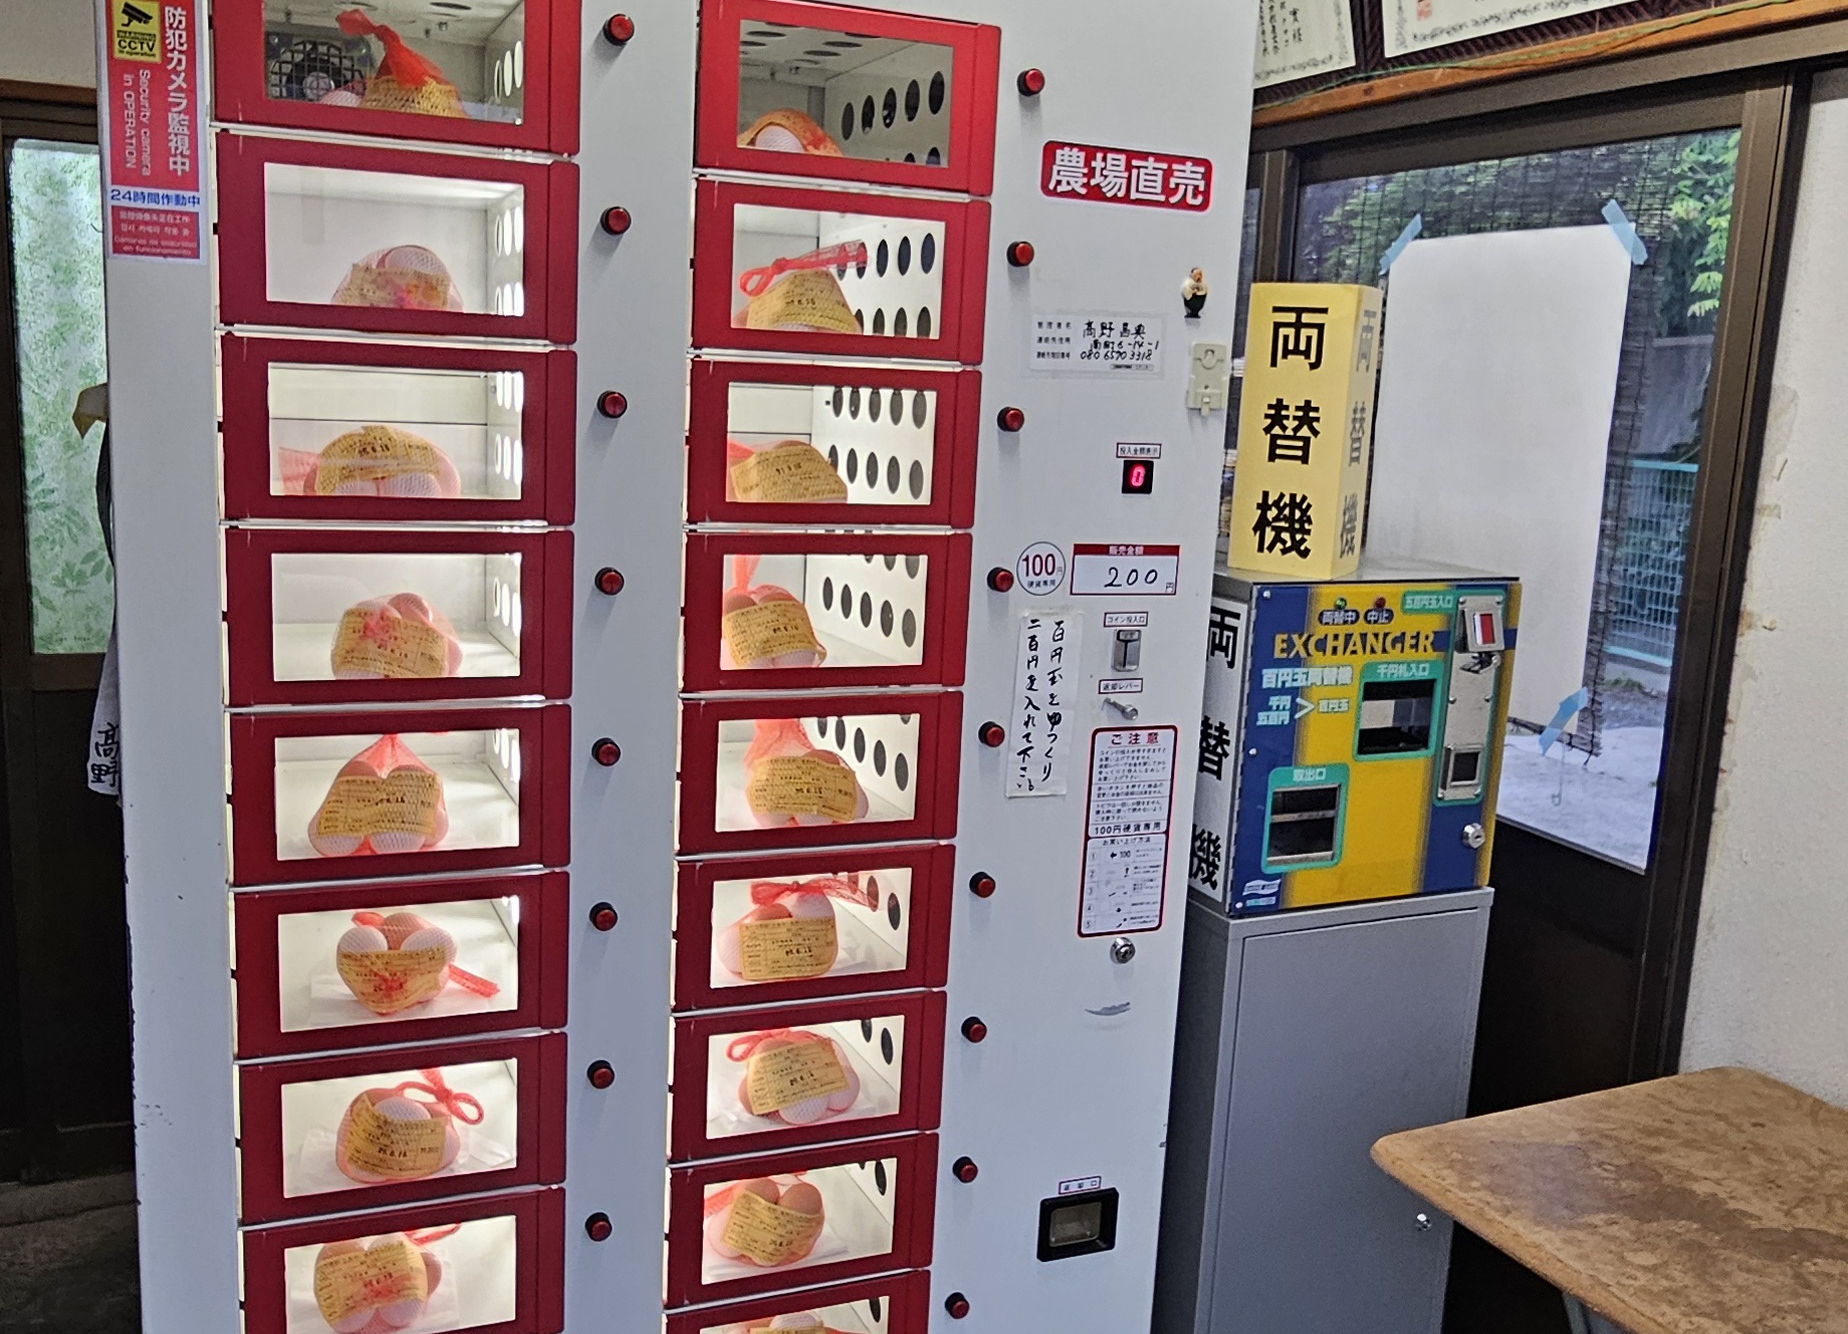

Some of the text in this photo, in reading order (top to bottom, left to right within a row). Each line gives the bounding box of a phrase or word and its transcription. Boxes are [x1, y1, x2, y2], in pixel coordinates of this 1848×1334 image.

[117, 38, 156, 53] CCTV
[164, 5, 191, 177] 防犯カメラ監視中
[1048, 146, 1206, 206] 農場直売
[110, 188, 200, 208] 24時間作動中
[1251, 305, 1329, 560] 両替機
[1339, 307, 1377, 560] 両替機
[1129, 464, 1146, 488] 0
[1103, 566, 1159, 589] 200
[1164, 581, 1175, 594] 円
[1366, 611, 1390, 624] 中止
[1273, 630, 1434, 659] EXCHANGER
[1110, 731, 1160, 746] ご注意
[90, 721, 119, 787] 高野
